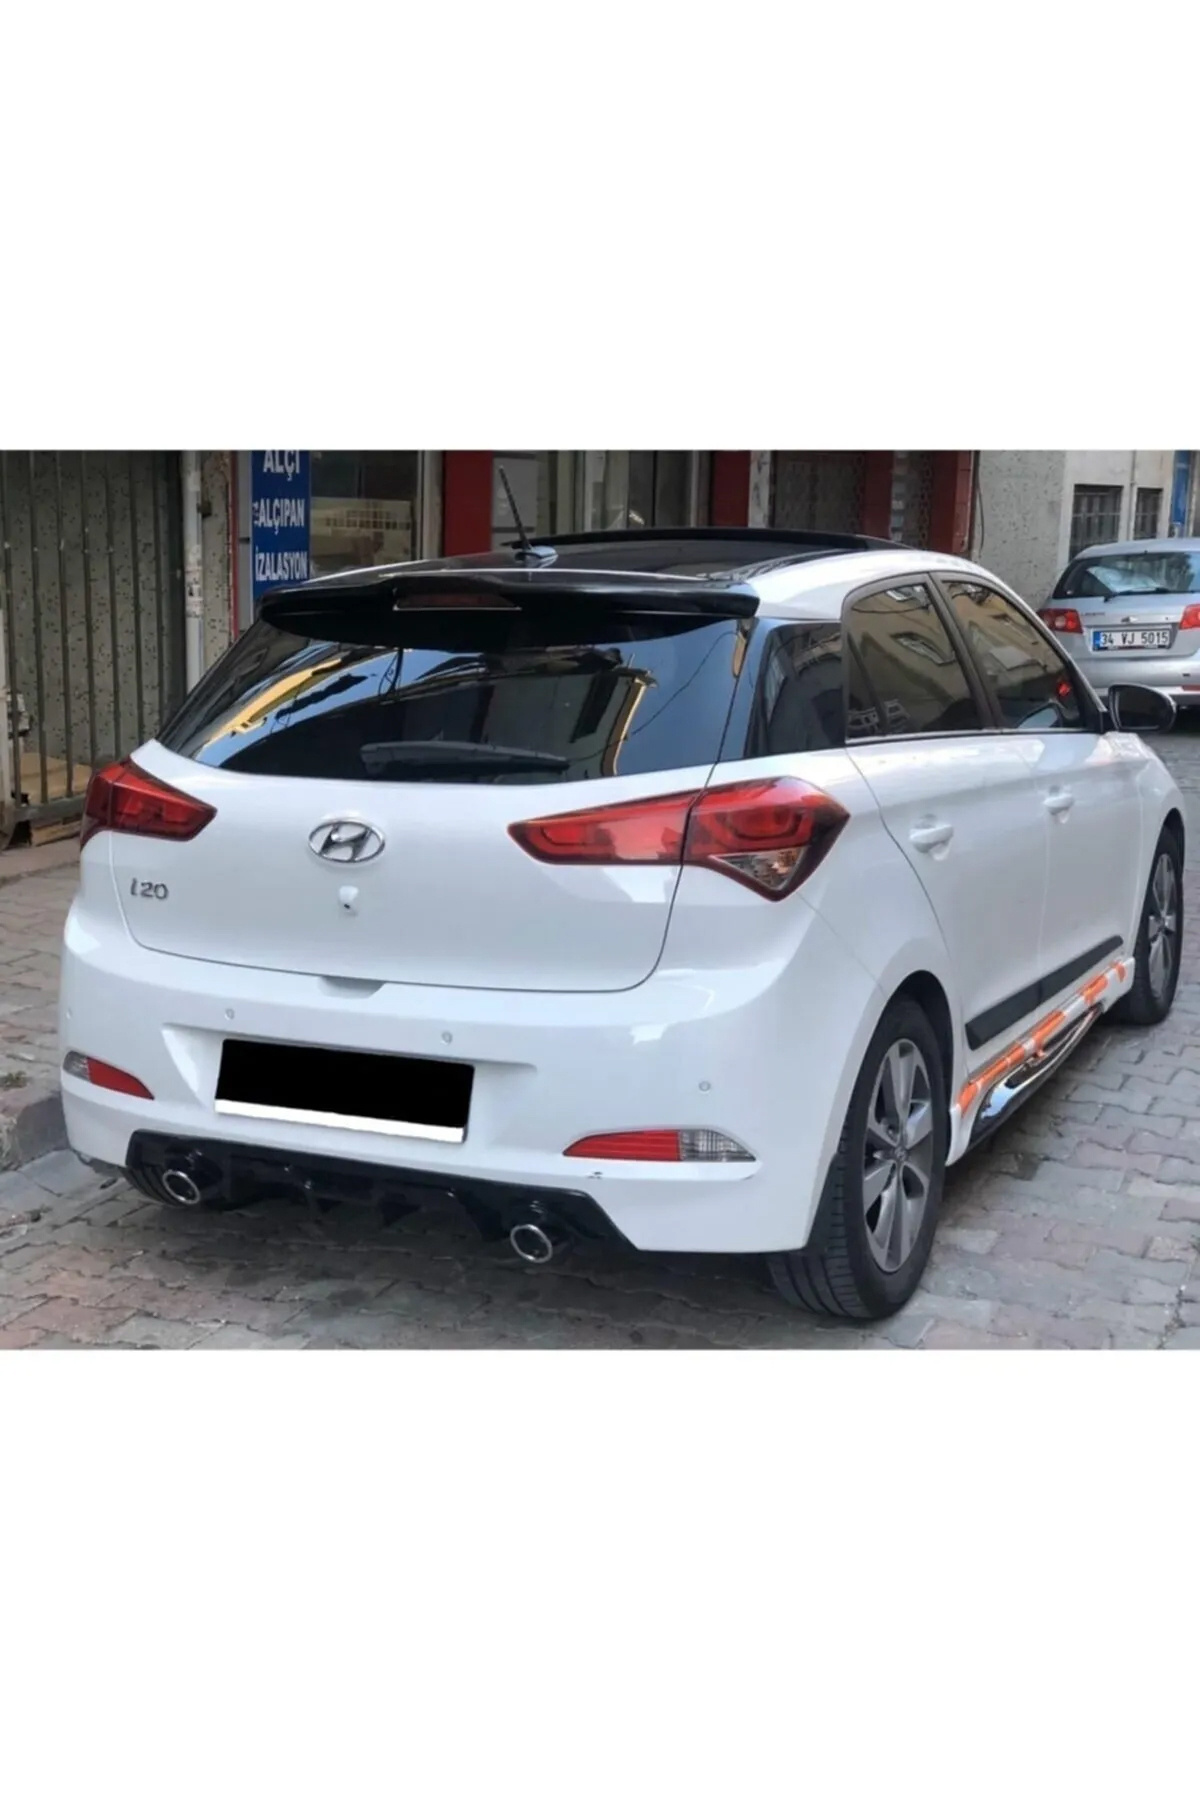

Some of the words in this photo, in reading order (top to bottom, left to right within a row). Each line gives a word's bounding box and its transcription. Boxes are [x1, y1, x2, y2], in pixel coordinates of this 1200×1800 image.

[259, 498, 305, 535] ALÇIPAN
[255, 545, 308, 581] İZALASYON
[1102, 633, 1114, 645] 34
[1121, 632, 1135, 646] VJ
[1141, 631, 1169, 645] 5015
